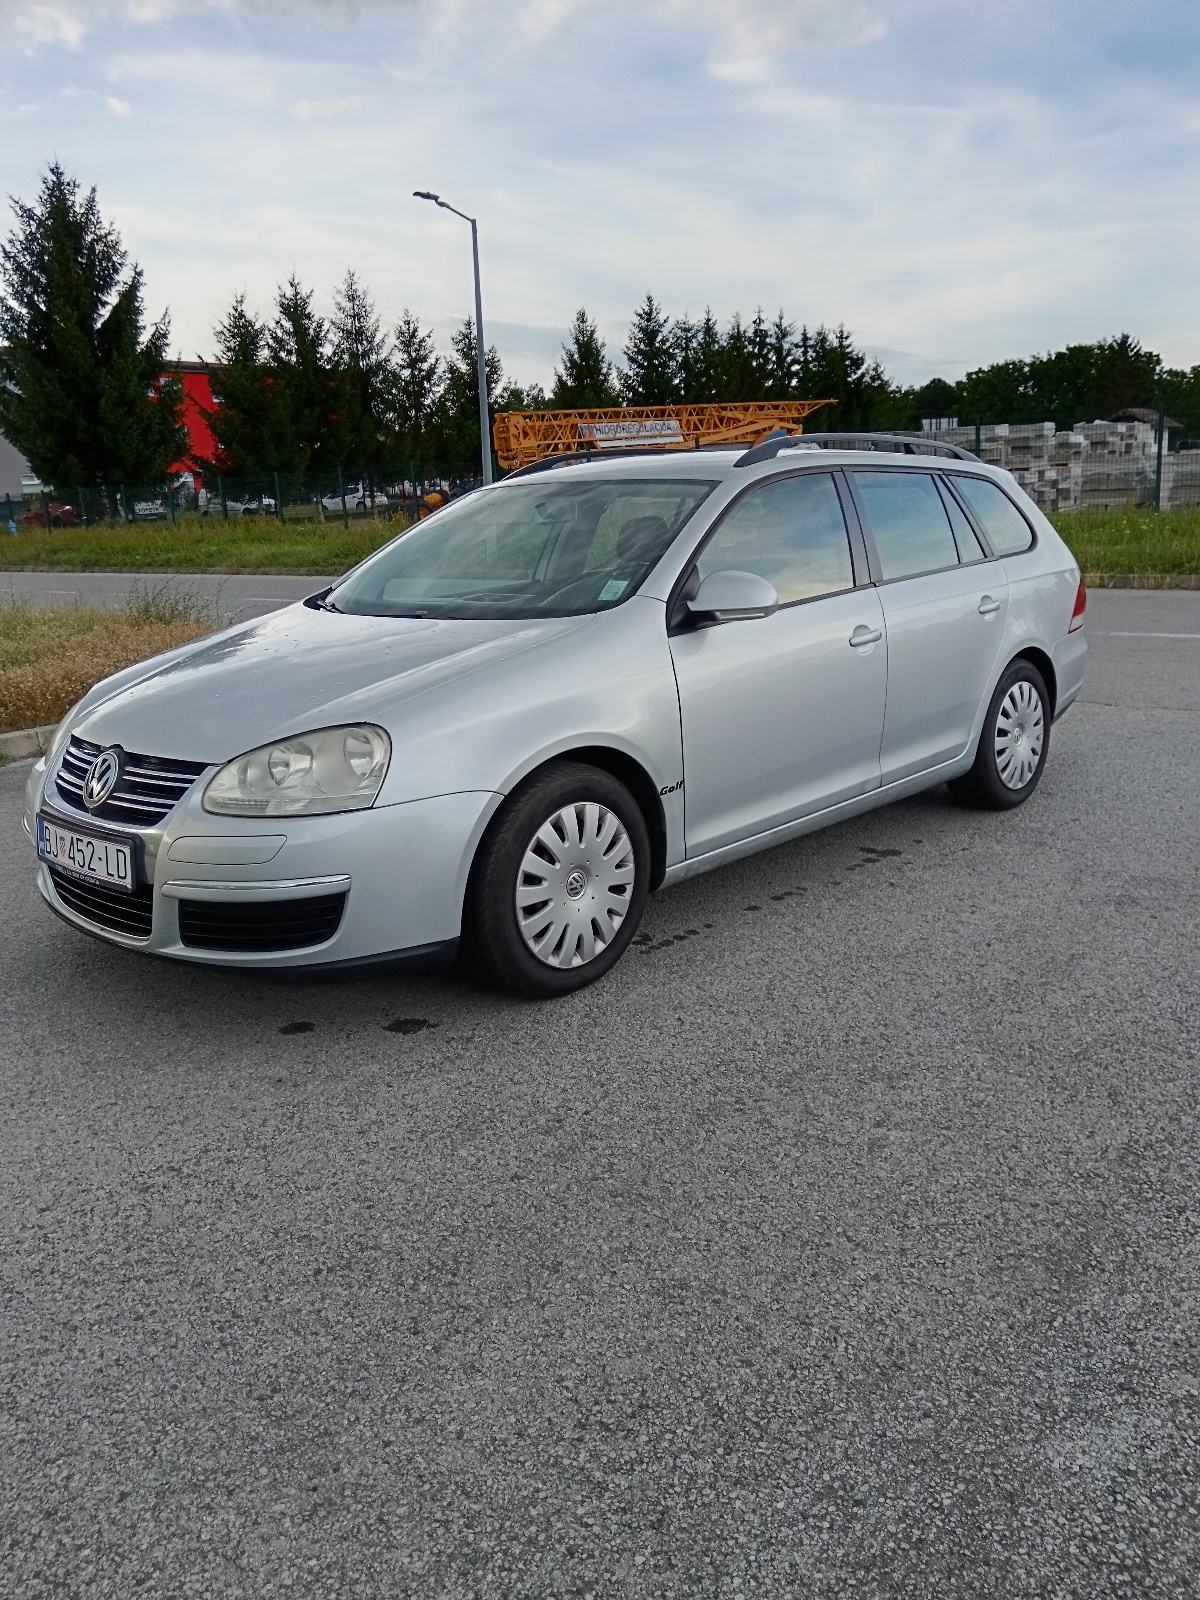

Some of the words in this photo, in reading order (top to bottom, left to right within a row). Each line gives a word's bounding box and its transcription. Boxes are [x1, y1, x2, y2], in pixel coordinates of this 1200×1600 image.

[659, 780, 685, 796] Golf
[44, 825, 59, 858] BJ
[68, 836, 127, 880] 452-LD
